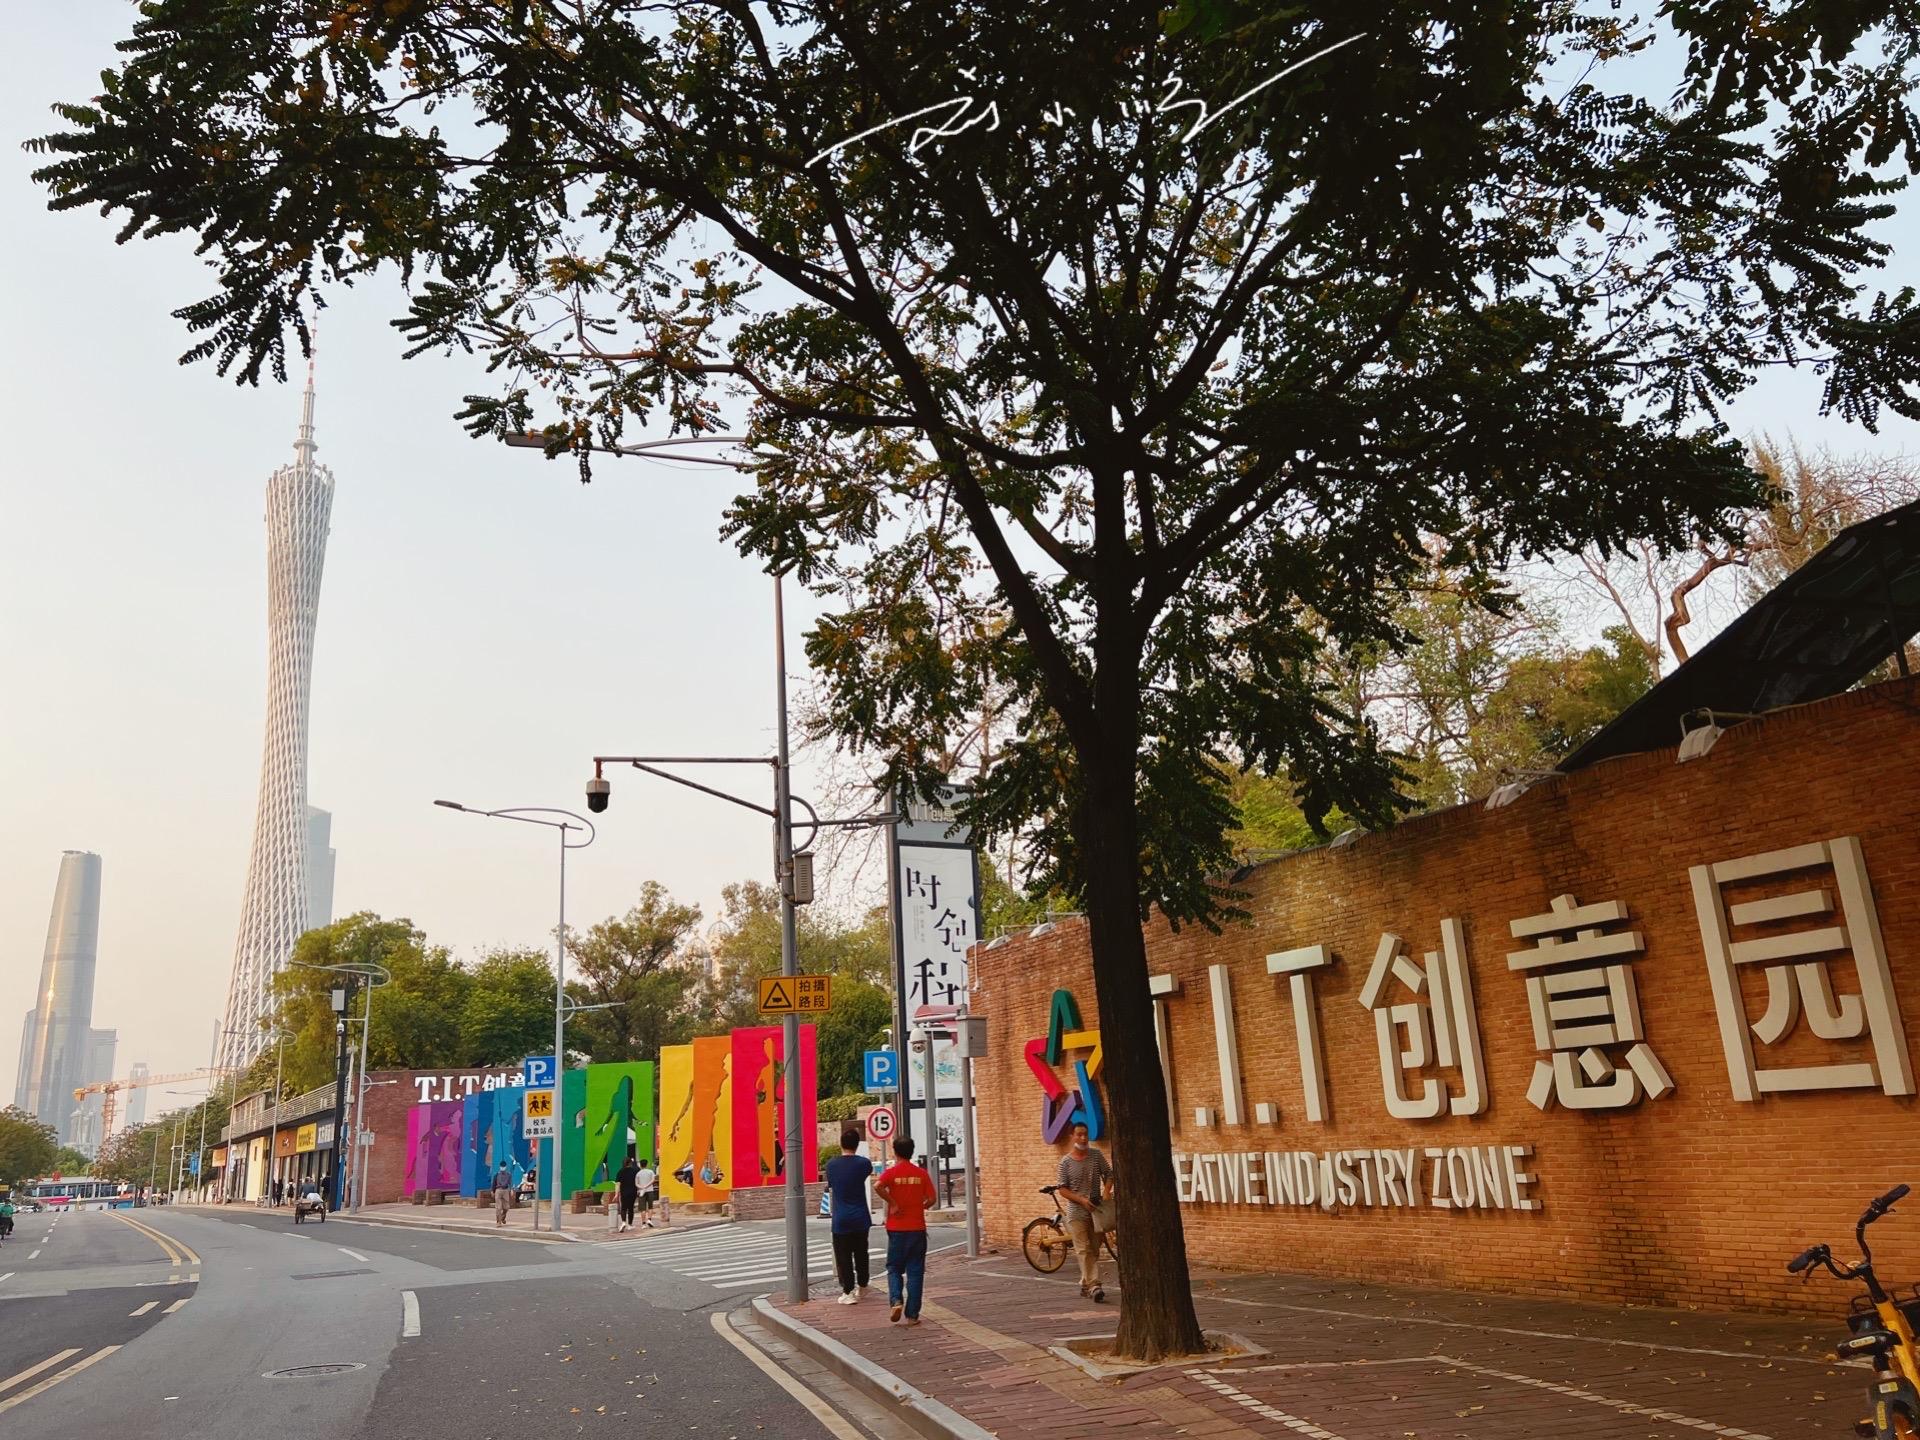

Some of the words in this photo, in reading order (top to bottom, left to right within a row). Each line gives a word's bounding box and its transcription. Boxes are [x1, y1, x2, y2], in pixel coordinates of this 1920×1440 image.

[799, 979, 825, 992] 拍摄
[799, 996, 825, 1008] 路段
[528, 1060, 547, 1086] P
[873, 1057, 891, 1082] P
[874, 1116, 890, 1131] 15
[1264, 1150, 1418, 1212] INDUSTRY
[1425, 1145, 1542, 1210] ZONE
